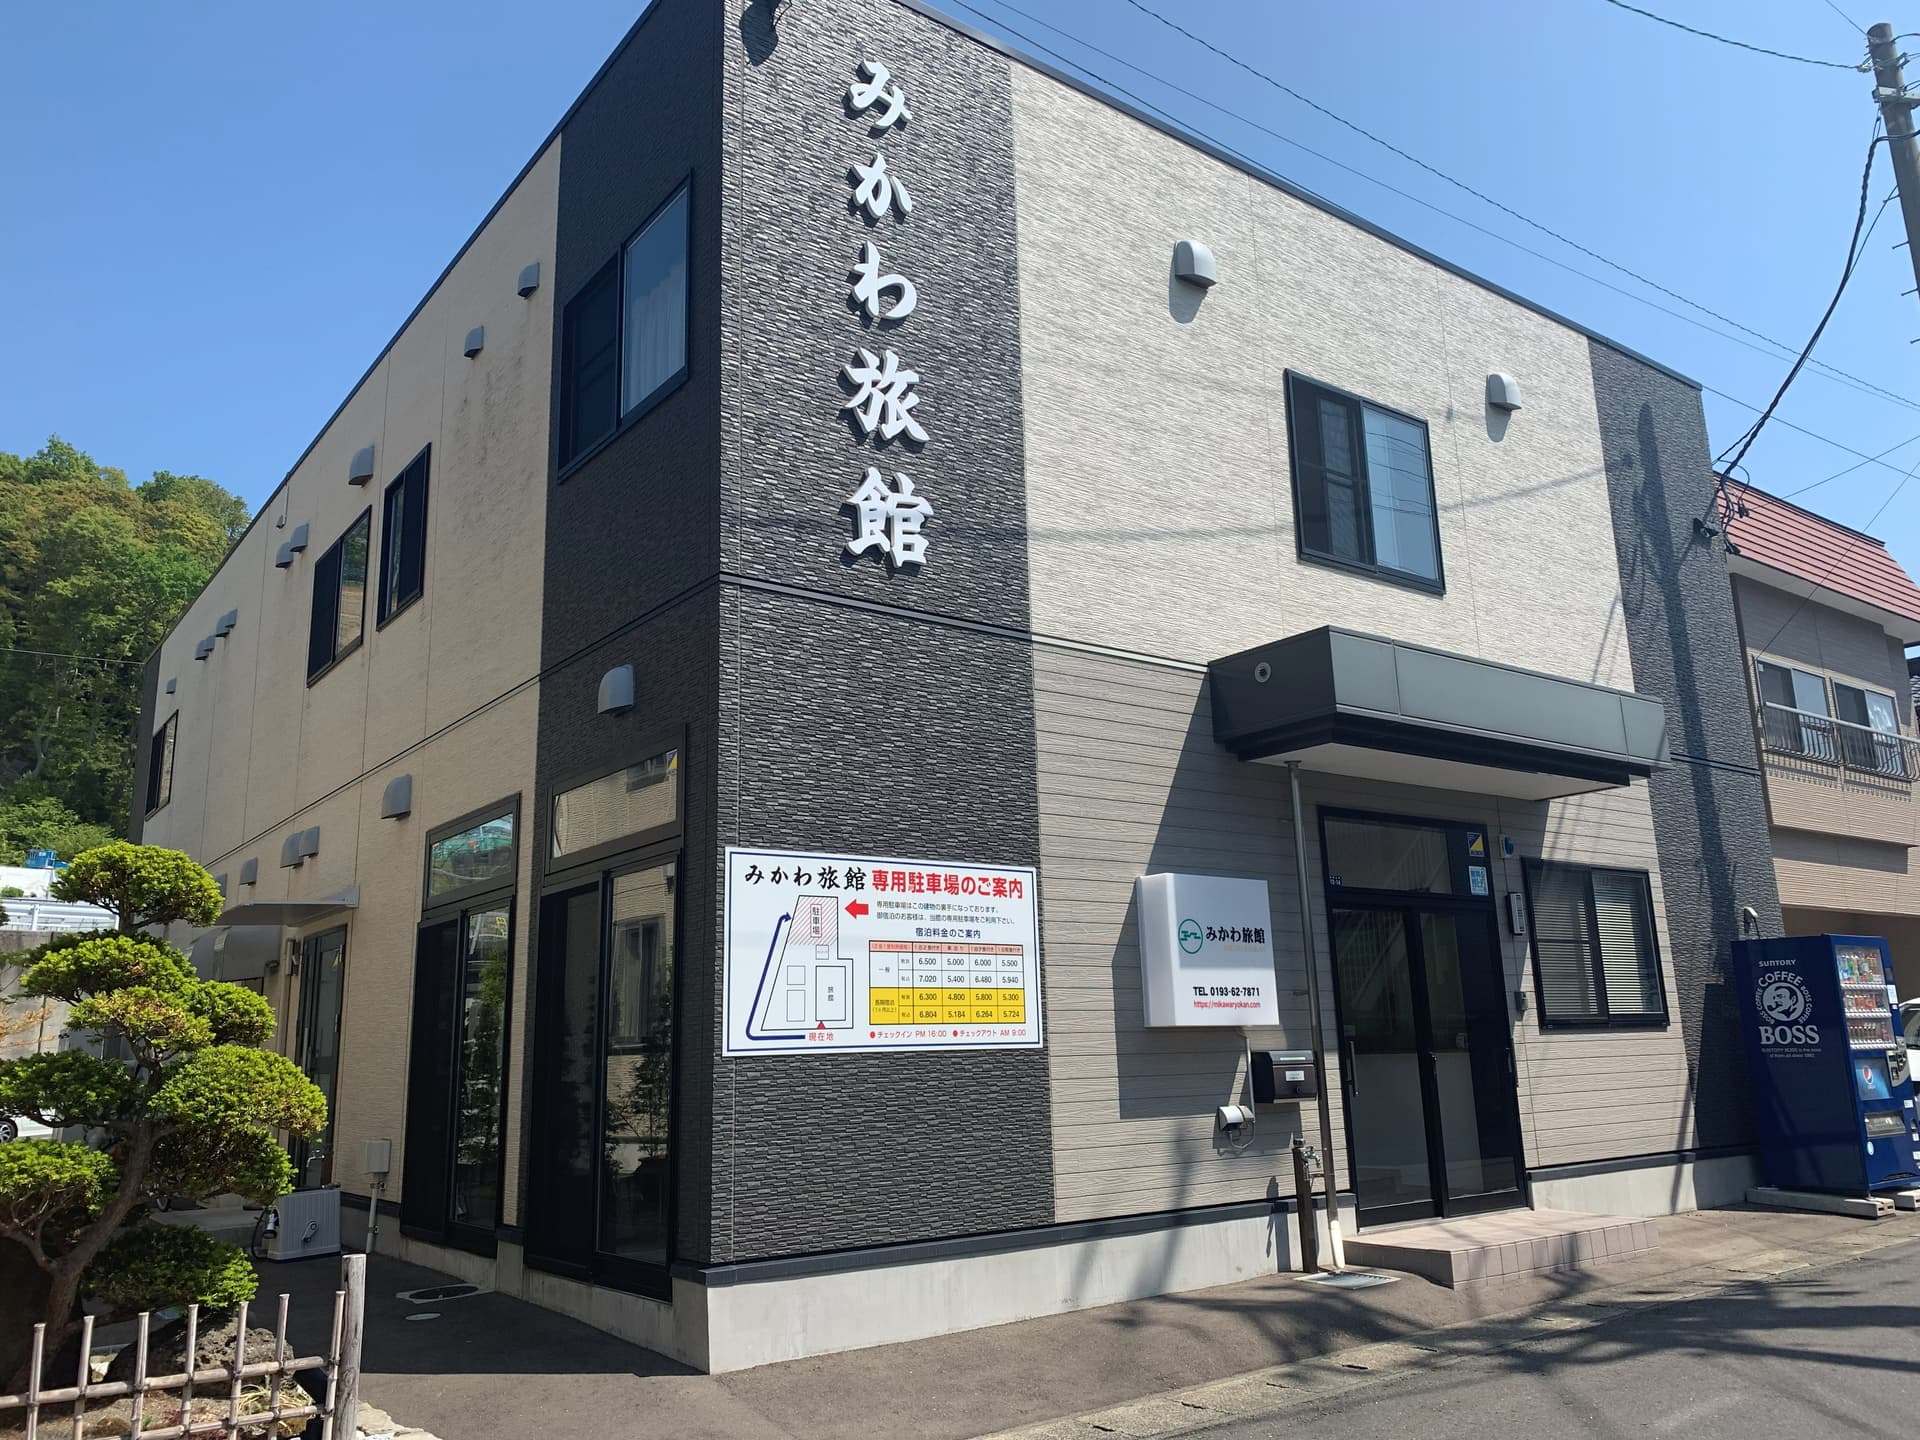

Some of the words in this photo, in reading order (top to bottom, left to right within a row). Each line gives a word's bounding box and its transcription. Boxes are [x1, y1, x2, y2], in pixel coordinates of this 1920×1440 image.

[842, 59, 934, 567] みかわ旅館
[745, 864, 867, 891] みかわ旅館
[871, 869, 1023, 899] 専用駐車場のご案内
[915, 927, 981, 939] 宿泊料金のご案内
[1206, 926, 1265, 944] みかわ旅館
[1758, 959, 1796, 967] SUNTORY
[1758, 970, 1803, 987] COFFEE
[1193, 986, 1208, 996] TEL
[1210, 986, 1260, 996] 0193-62-7871
[808, 1032, 834, 1041] 現在地
[877, 1031, 913, 1039] チェックイン
[959, 1030, 997, 1038] チェックアウト
[1000, 1029, 1010, 1037] AM
[1758, 1025, 1820, 1045] BOSS
